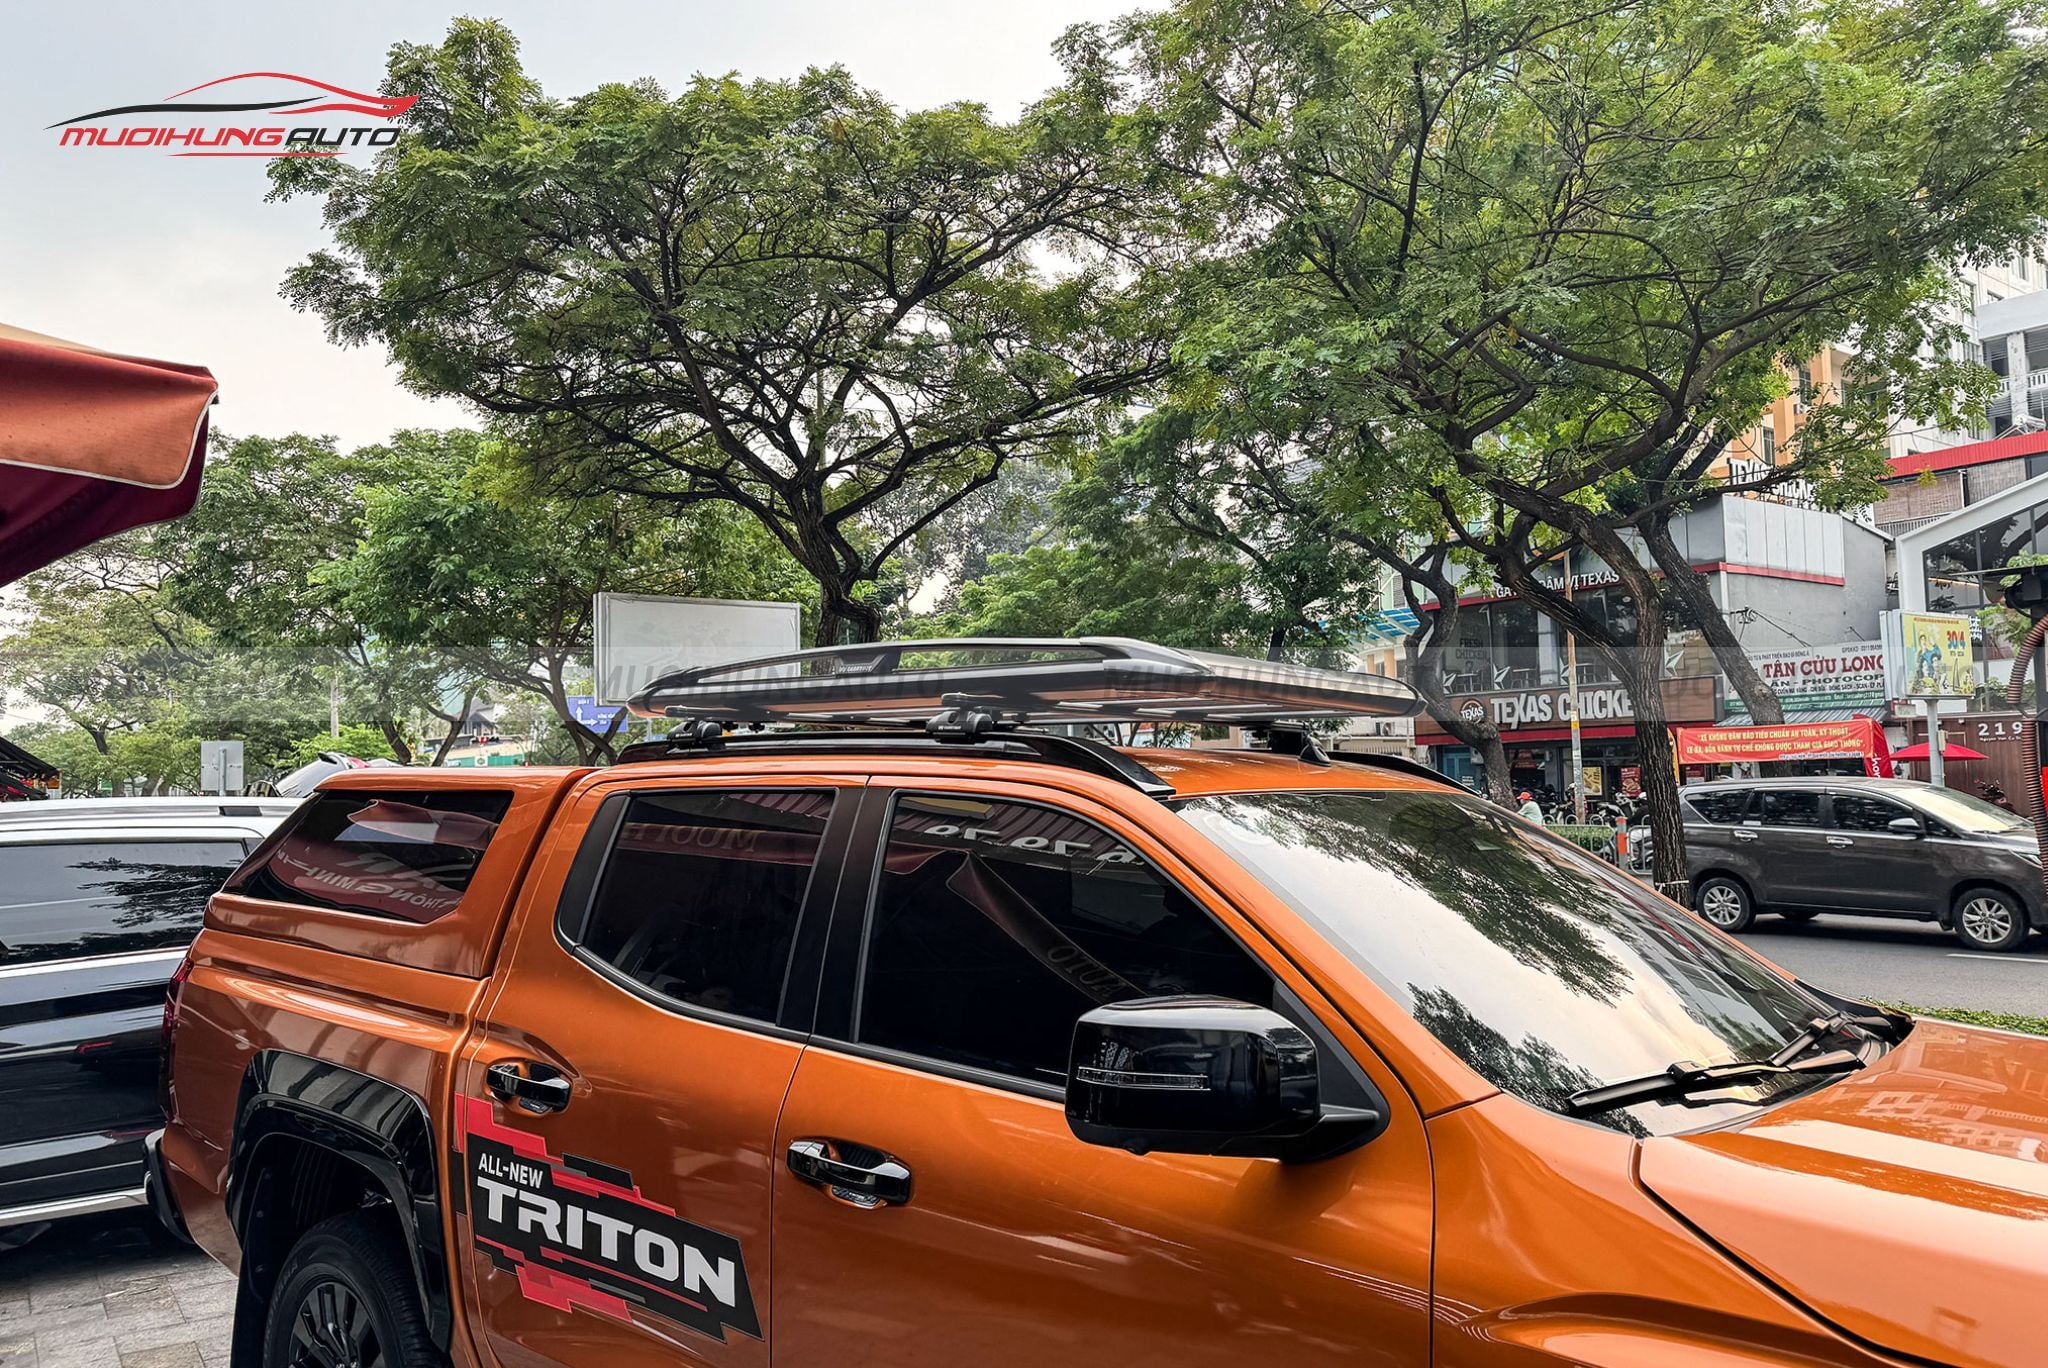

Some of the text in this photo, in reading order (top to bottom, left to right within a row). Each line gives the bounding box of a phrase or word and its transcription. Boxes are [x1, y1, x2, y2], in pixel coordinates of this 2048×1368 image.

[1580, 570, 1619, 587] TEXAS
[1763, 659, 1796, 679] TÂN
[1800, 655, 1837, 676] CỬU
[1461, 706, 1483, 722] TEXAS
[1491, 689, 1635, 729] TEXAS CHICKE
[478, 1152, 543, 1190] ALL-NEW
[477, 1175, 735, 1307] TRITON
